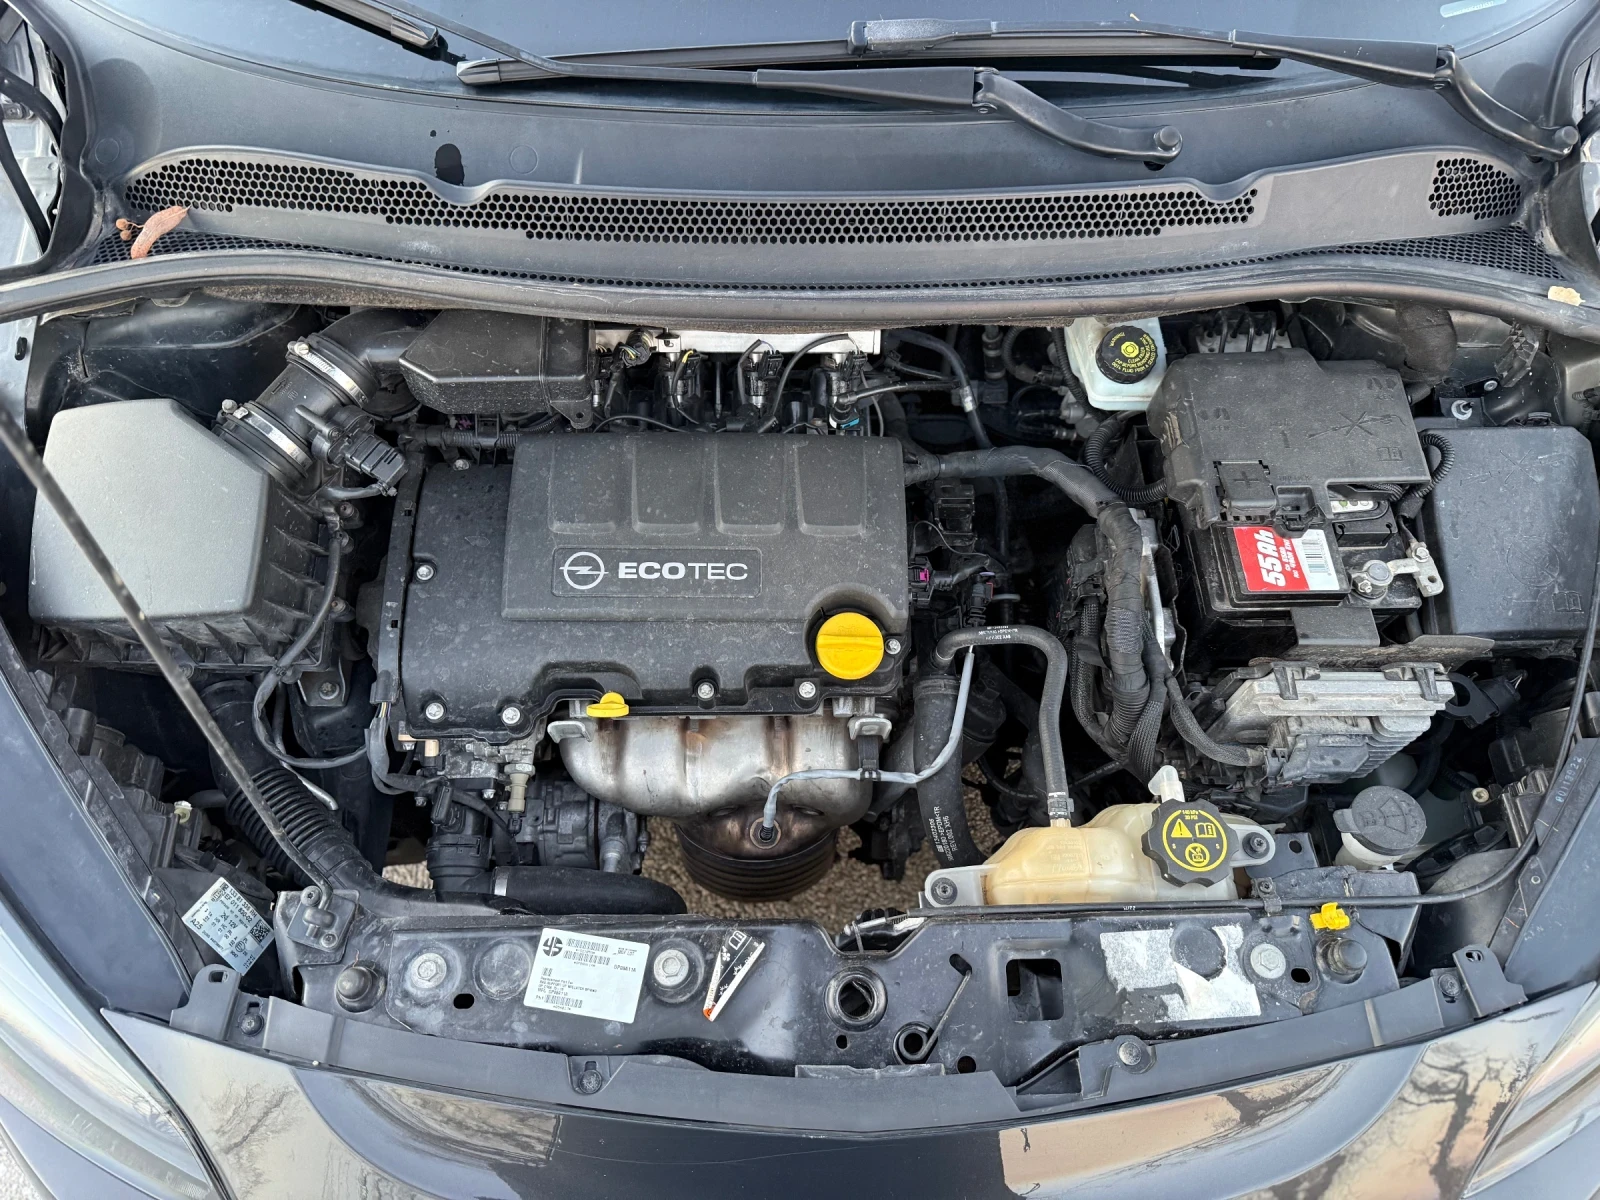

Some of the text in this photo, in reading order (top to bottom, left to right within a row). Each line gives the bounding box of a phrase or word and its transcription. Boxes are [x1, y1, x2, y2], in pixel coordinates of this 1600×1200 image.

[1254, 529, 1286, 586] 55Ah
[618, 562, 748, 580] ECOTEC
[190, 918, 203, 929] A25
